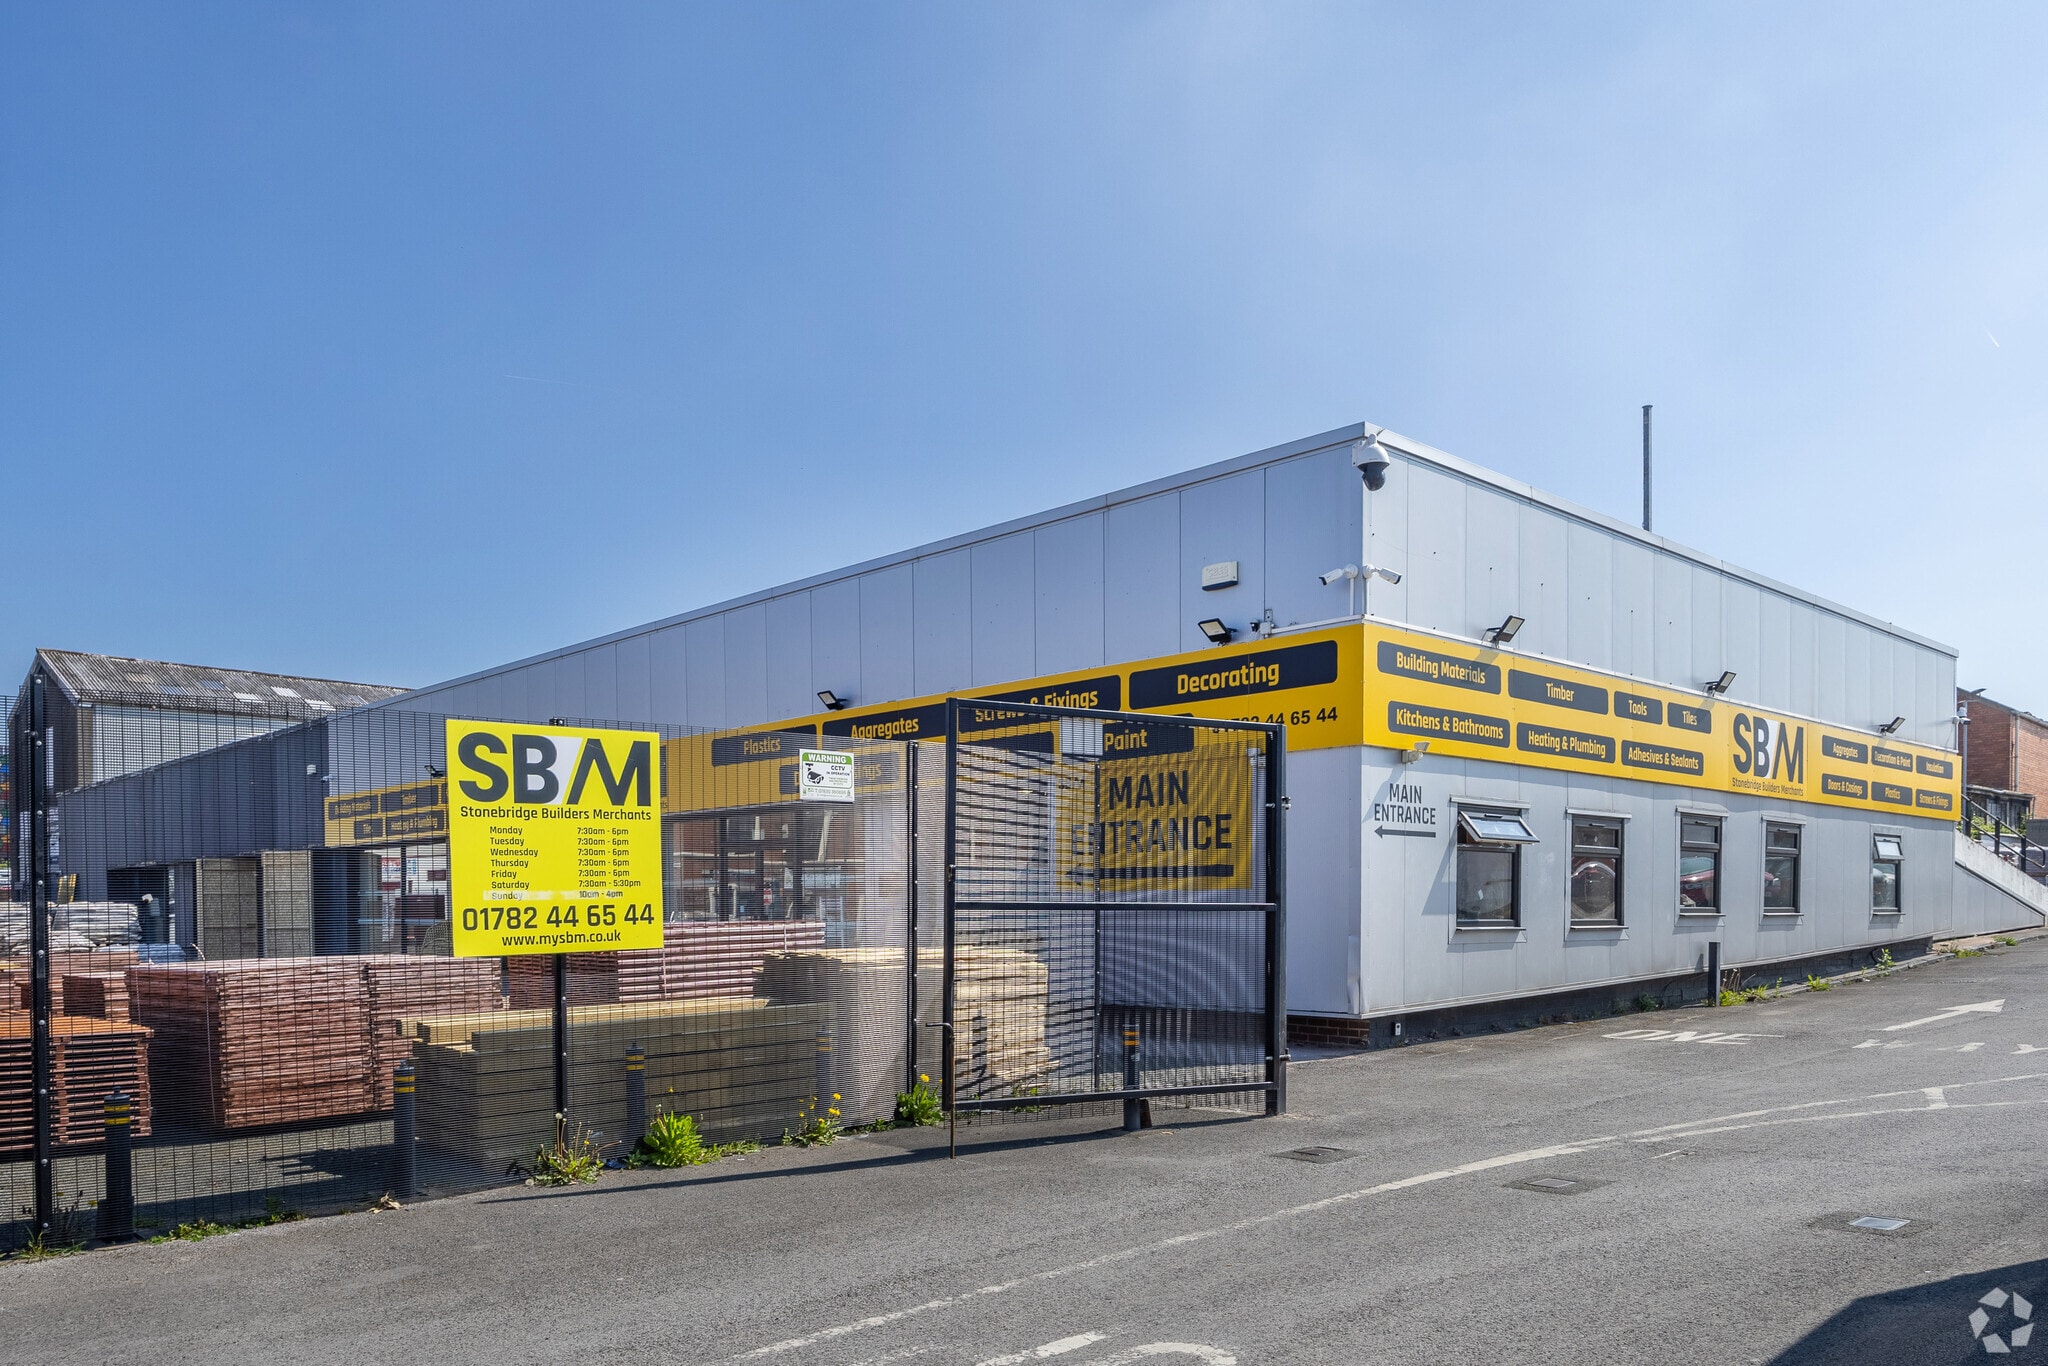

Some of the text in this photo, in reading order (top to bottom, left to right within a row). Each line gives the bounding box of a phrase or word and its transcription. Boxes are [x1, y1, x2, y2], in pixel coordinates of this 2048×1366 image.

[1396, 651, 1486, 684] Building Materials
[1177, 661, 1280, 695] Decorating
[1044, 690, 1098, 710] Fixings
[1546, 683, 1575, 702] Timber
[1290, 710, 1311, 726] 65
[1316, 706, 1338, 722] 44
[1628, 700, 1648, 716] Tools
[1396, 708, 1504, 739] Kitchens & Bathrooms
[1682, 710, 1698, 726] Tiles
[851, 718, 919, 740] Aggregates
[743, 736, 781, 755] Plastics
[1103, 728, 1148, 752] Paint
[1528, 730, 1606, 758] Heating & Plumbing
[1733, 712, 1804, 784] SBM
[807, 753, 847, 764] WARNING
[1628, 747, 1699, 770] Adhesives & Sealants
[1833, 742, 1859, 759] Aggregates
[457, 731, 652, 807] SBM
[1109, 770, 1188, 810] MAIN
[1389, 783, 1422, 804] MAIN
[1731, 777, 1762, 793] Stonebridge
[460, 806, 652, 821] Stonebridge Builders Merchants
[1374, 803, 1436, 825] ENTRANCE
[490, 826, 523, 836] Monday
[577, 827, 605, 835] 7:30am
[612, 827, 628, 836] 6pm
[1071, 813, 1232, 855] ENTRANCE
[490, 837, 525, 846] Tuesday
[577, 838, 605, 846] 7:30am
[612, 838, 628, 847] 6pm
[490, 848, 539, 857] Wednesday
[577, 848, 606, 856] 7:30am
[612, 848, 629, 857] 6pm
[491, 859, 529, 868] Thursday
[578, 859, 606, 867] 7:30am
[612, 859, 629, 868] 6pm
[491, 870, 517, 879] Friday
[578, 869, 606, 877] 7:30am
[612, 869, 629, 878] 6pm
[491, 881, 530, 890] Saturday
[578, 880, 607, 888] 7:30am
[613, 880, 641, 888] 5:30pm
[491, 892, 523, 901] Sunday
[462, 904, 655, 931] 01782 44 65 44
[502, 929, 621, 946] www.mysbm.co.uk
[1601, 1029, 1785, 1045] ONE
